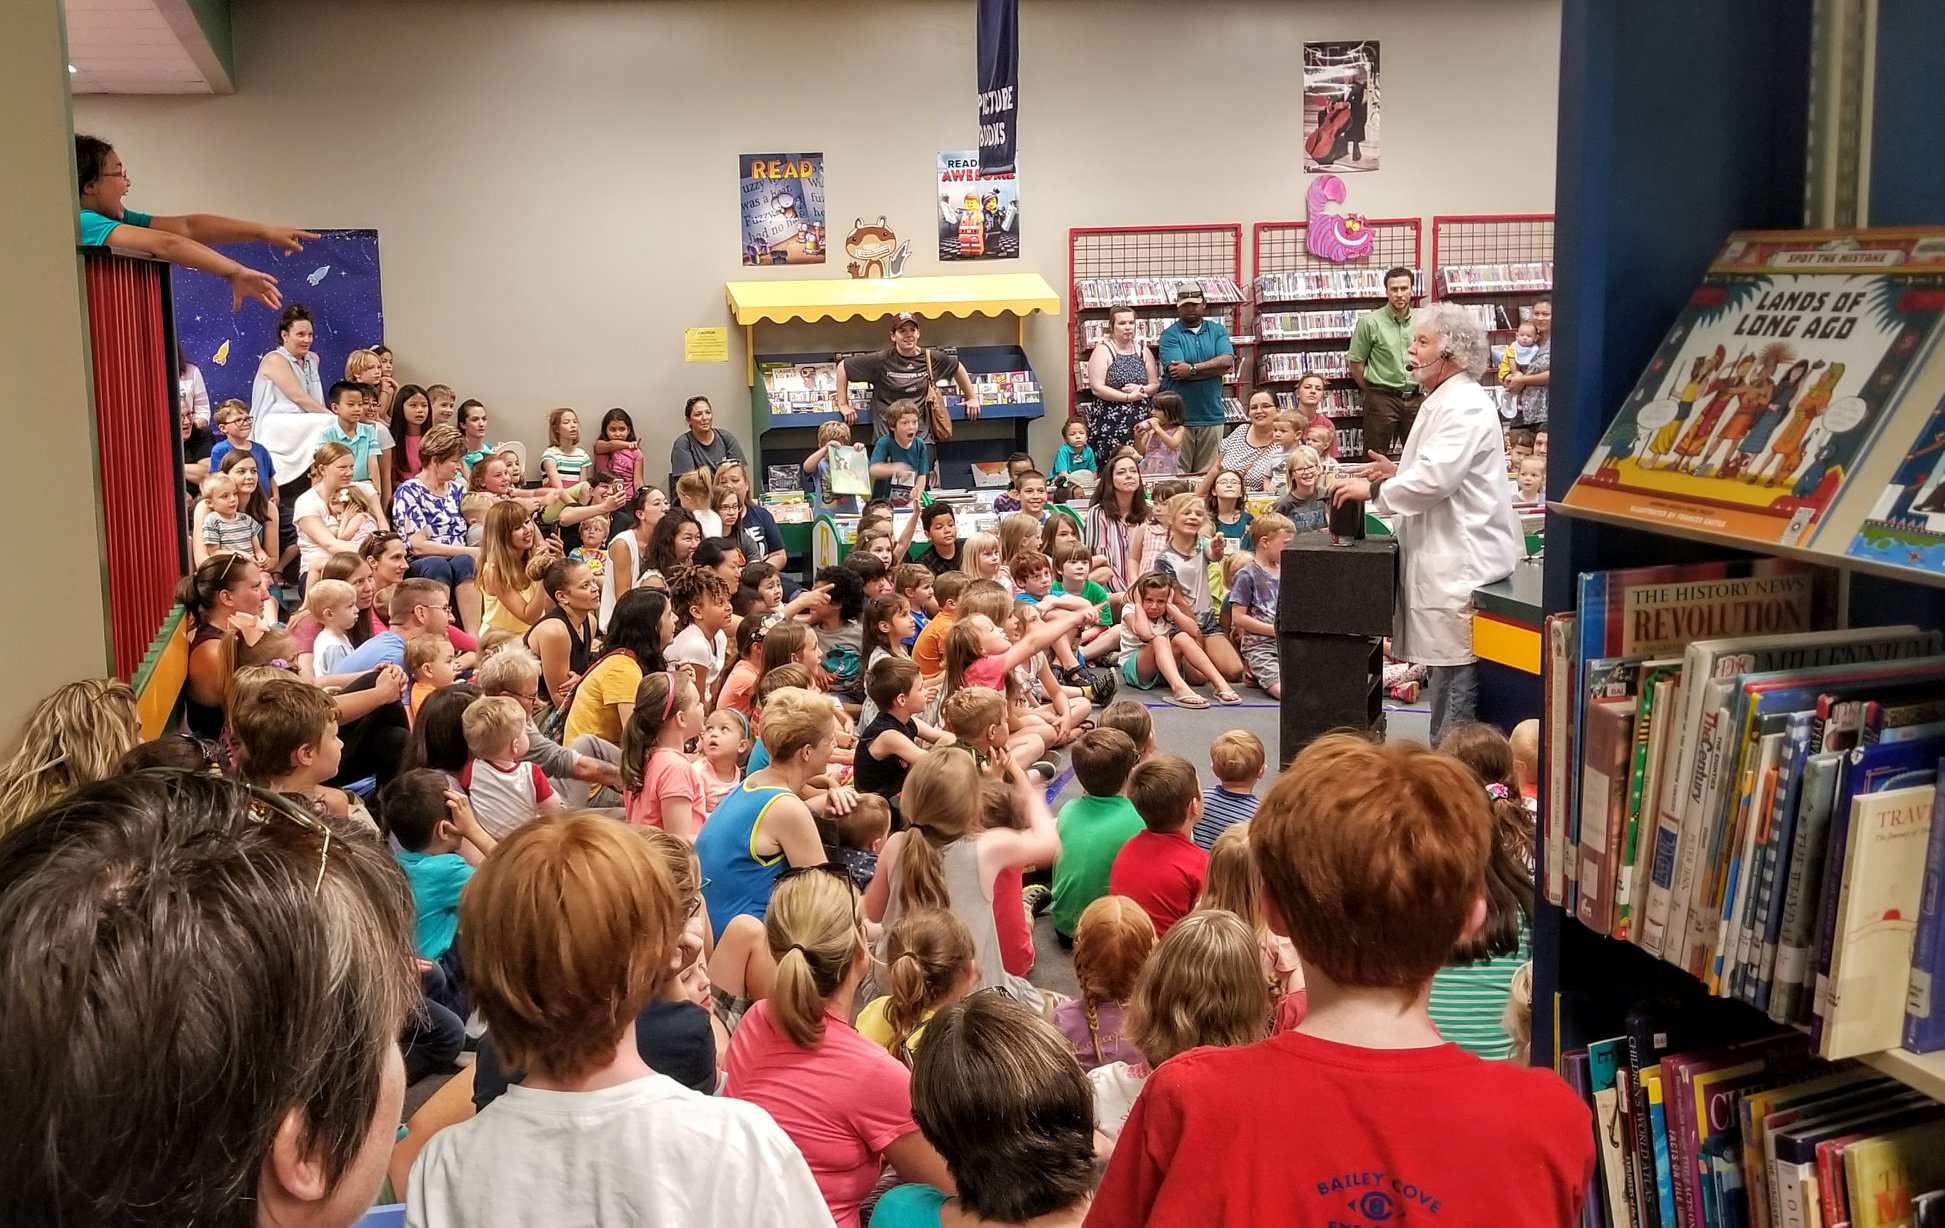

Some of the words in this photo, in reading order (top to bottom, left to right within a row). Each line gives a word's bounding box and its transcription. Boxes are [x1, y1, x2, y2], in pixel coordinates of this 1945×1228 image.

[751, 159, 814, 179] READ
[948, 159, 978, 168] READ
[741, 198, 761, 210] was
[763, 195, 769, 203] a
[772, 223, 784, 235] no
[1787, 253, 1816, 263] SPOT
[1816, 253, 1838, 263] THE
[1839, 253, 1887, 263] MISTAKE
[1756, 291, 1830, 312] LANDS
[1831, 292, 1867, 312] OF
[1733, 314, 1801, 338] LONG
[1801, 316, 1858, 339] AGO
[1633, 588, 1670, 605] THE
[1676, 582, 1750, 602] HISTORY
[1755, 576, 1806, 594] NEWS
[1633, 598, 1801, 642] REVOLUTION
[1710, 753, 1720, 790] EIGHTIES
[1794, 832, 1807, 865] THE
[1636, 1111, 1649, 1159] WORLD
[1668, 1129, 1679, 1161] FACTS
[1642, 1160, 1652, 1202] ATLAS
[1672, 1164, 1681, 1179] ON
[1317, 1172, 1385, 1196] BAILEY
[1391, 1179, 1443, 1214] COVE
[1674, 1180, 1684, 1202] FILE
